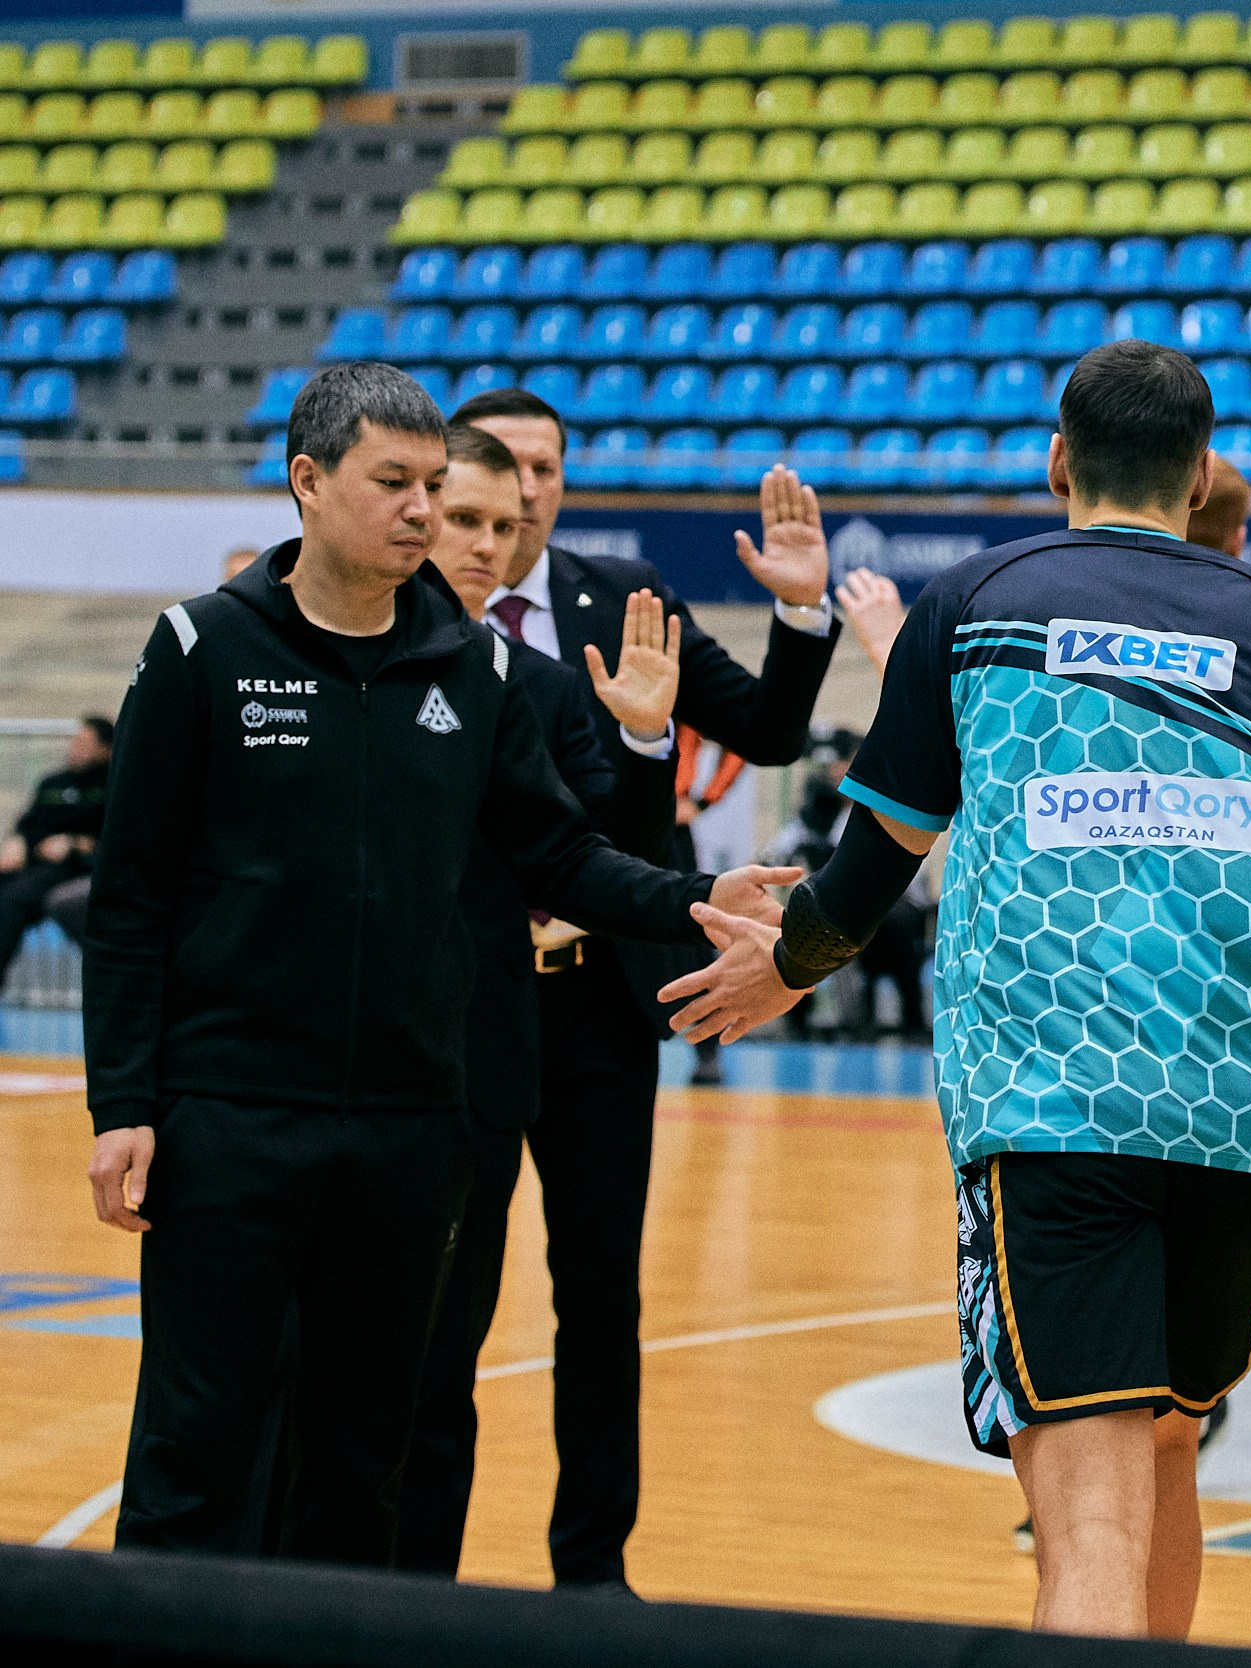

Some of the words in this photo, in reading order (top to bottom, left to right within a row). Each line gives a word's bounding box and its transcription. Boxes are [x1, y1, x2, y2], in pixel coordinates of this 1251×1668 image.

[1057, 630, 1225, 678] 1XBET
[237, 678, 319, 694] KELME
[243, 734, 276, 748] Sport
[278, 733, 310, 747] Qory
[1088, 825, 1215, 842] QAZAQSTAN
